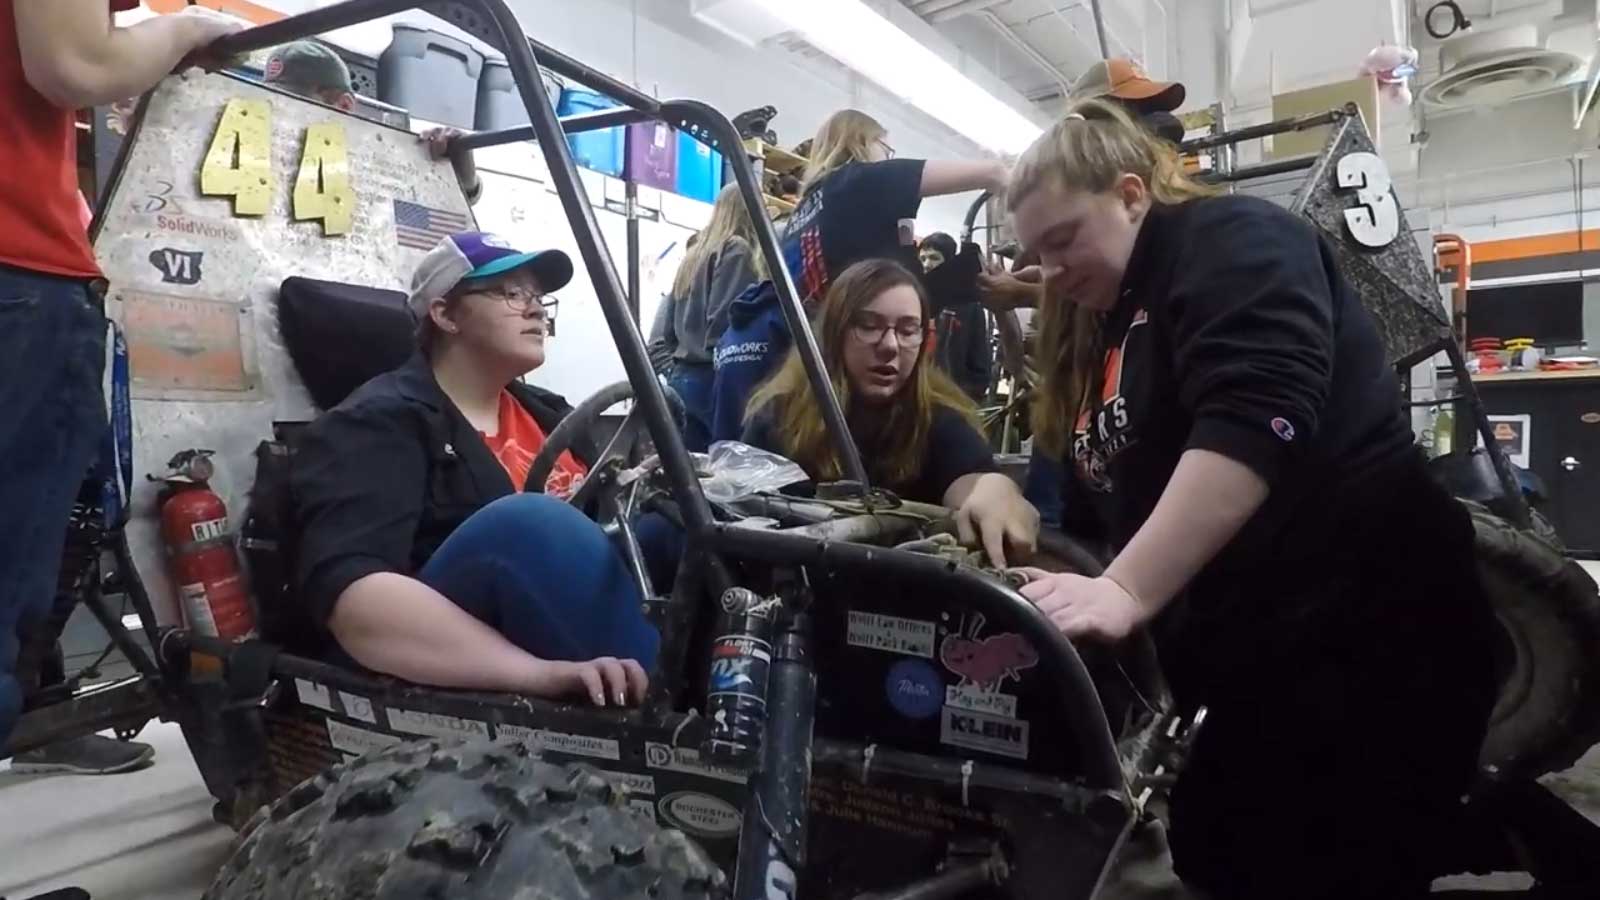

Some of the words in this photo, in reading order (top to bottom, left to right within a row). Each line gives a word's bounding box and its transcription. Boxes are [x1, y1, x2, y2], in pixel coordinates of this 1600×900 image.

[201, 98, 354, 235] 44
[1337, 152, 1399, 247] 3
[157, 214, 238, 241] SolidWorks
[164, 250, 192, 279] VI
[951, 712, 1022, 743] KLEIN
[675, 801, 736, 819] ROCHESTER
